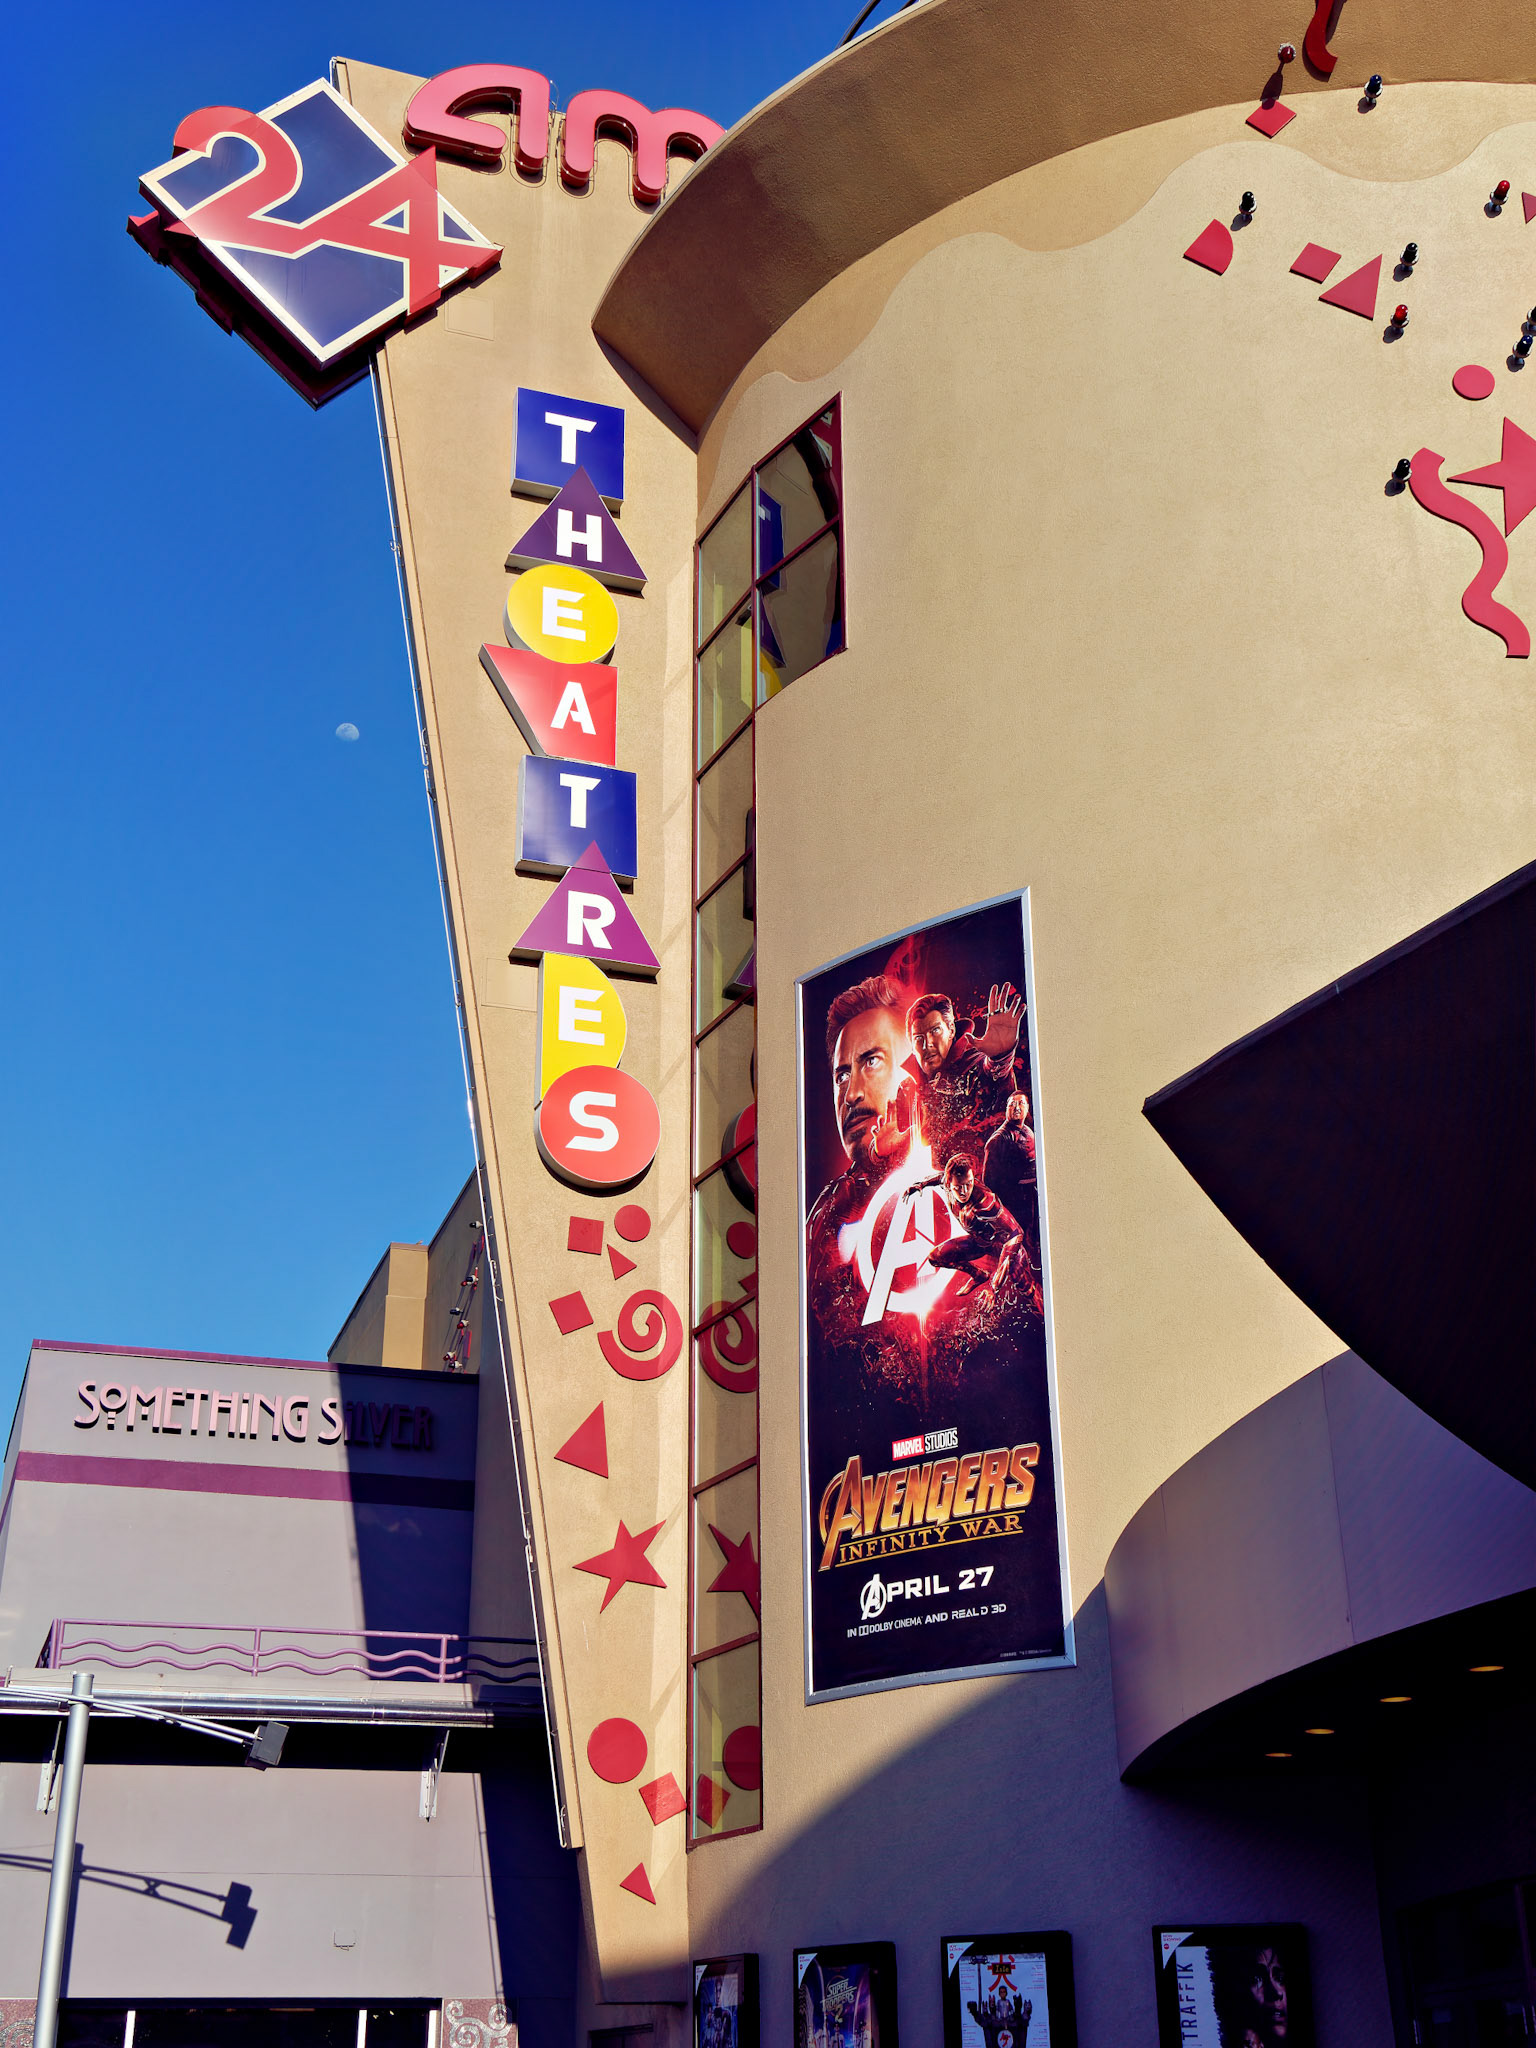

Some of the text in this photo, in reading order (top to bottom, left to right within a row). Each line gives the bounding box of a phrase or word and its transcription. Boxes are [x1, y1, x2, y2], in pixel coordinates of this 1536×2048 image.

[158, 105, 503, 317] 24
[542, 411, 620, 1153] THEATRES
[893, 1429, 958, 1459] MARVEL STUDIOS
[818, 1442, 1040, 1572] AVENGERS
[839, 1514, 1023, 1563] INFINITY WAR
[860, 1566, 995, 1620] APRIL 27
[847, 1628, 857, 1638] IN
[869, 1620, 894, 1635] DOLBY
[894, 1617, 922, 1630] CINEMA
[925, 1612, 948, 1624] AND
[991, 1603, 1007, 1614] 3D
[827, 1978, 850, 1998] SUPER
[1177, 1964, 1198, 2040] TRAFFIK
